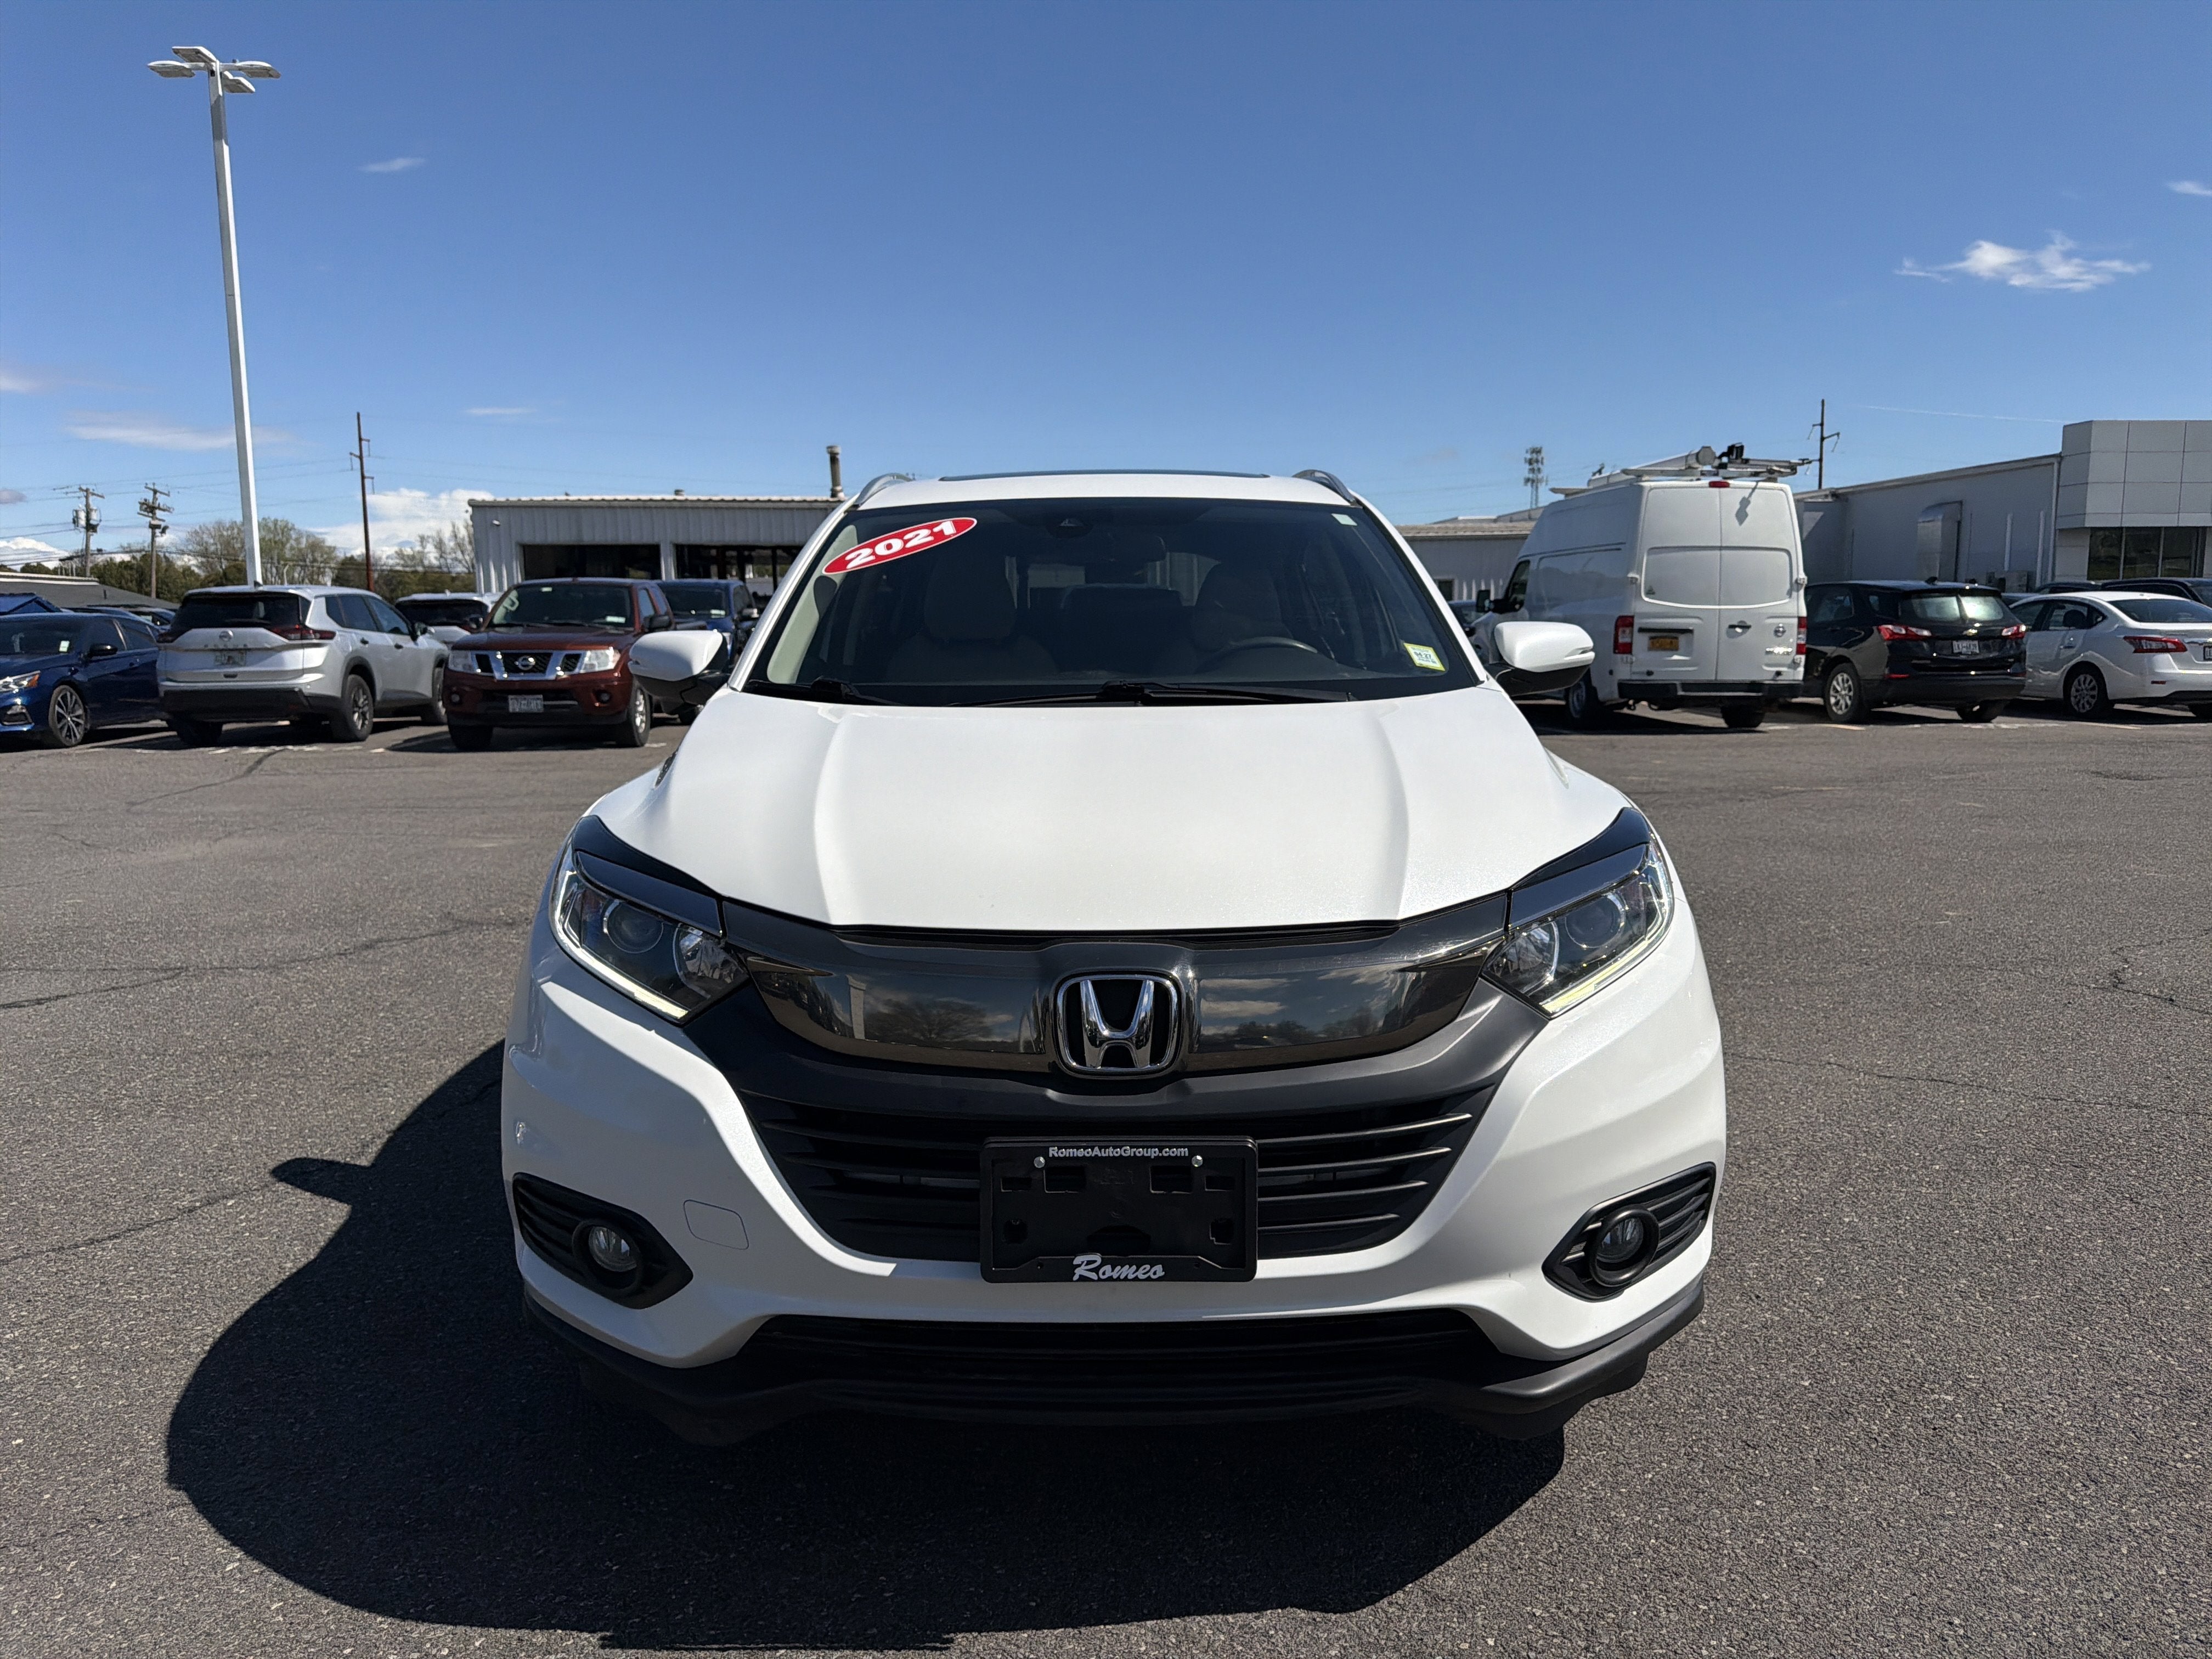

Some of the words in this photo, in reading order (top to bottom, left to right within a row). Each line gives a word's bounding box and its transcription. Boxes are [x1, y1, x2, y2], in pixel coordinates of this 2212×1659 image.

[845, 520, 957, 569] 2021
[1048, 1146, 1189, 1159] RomeoAutoGroup.com
[1073, 1254, 1165, 1281] Romeo
